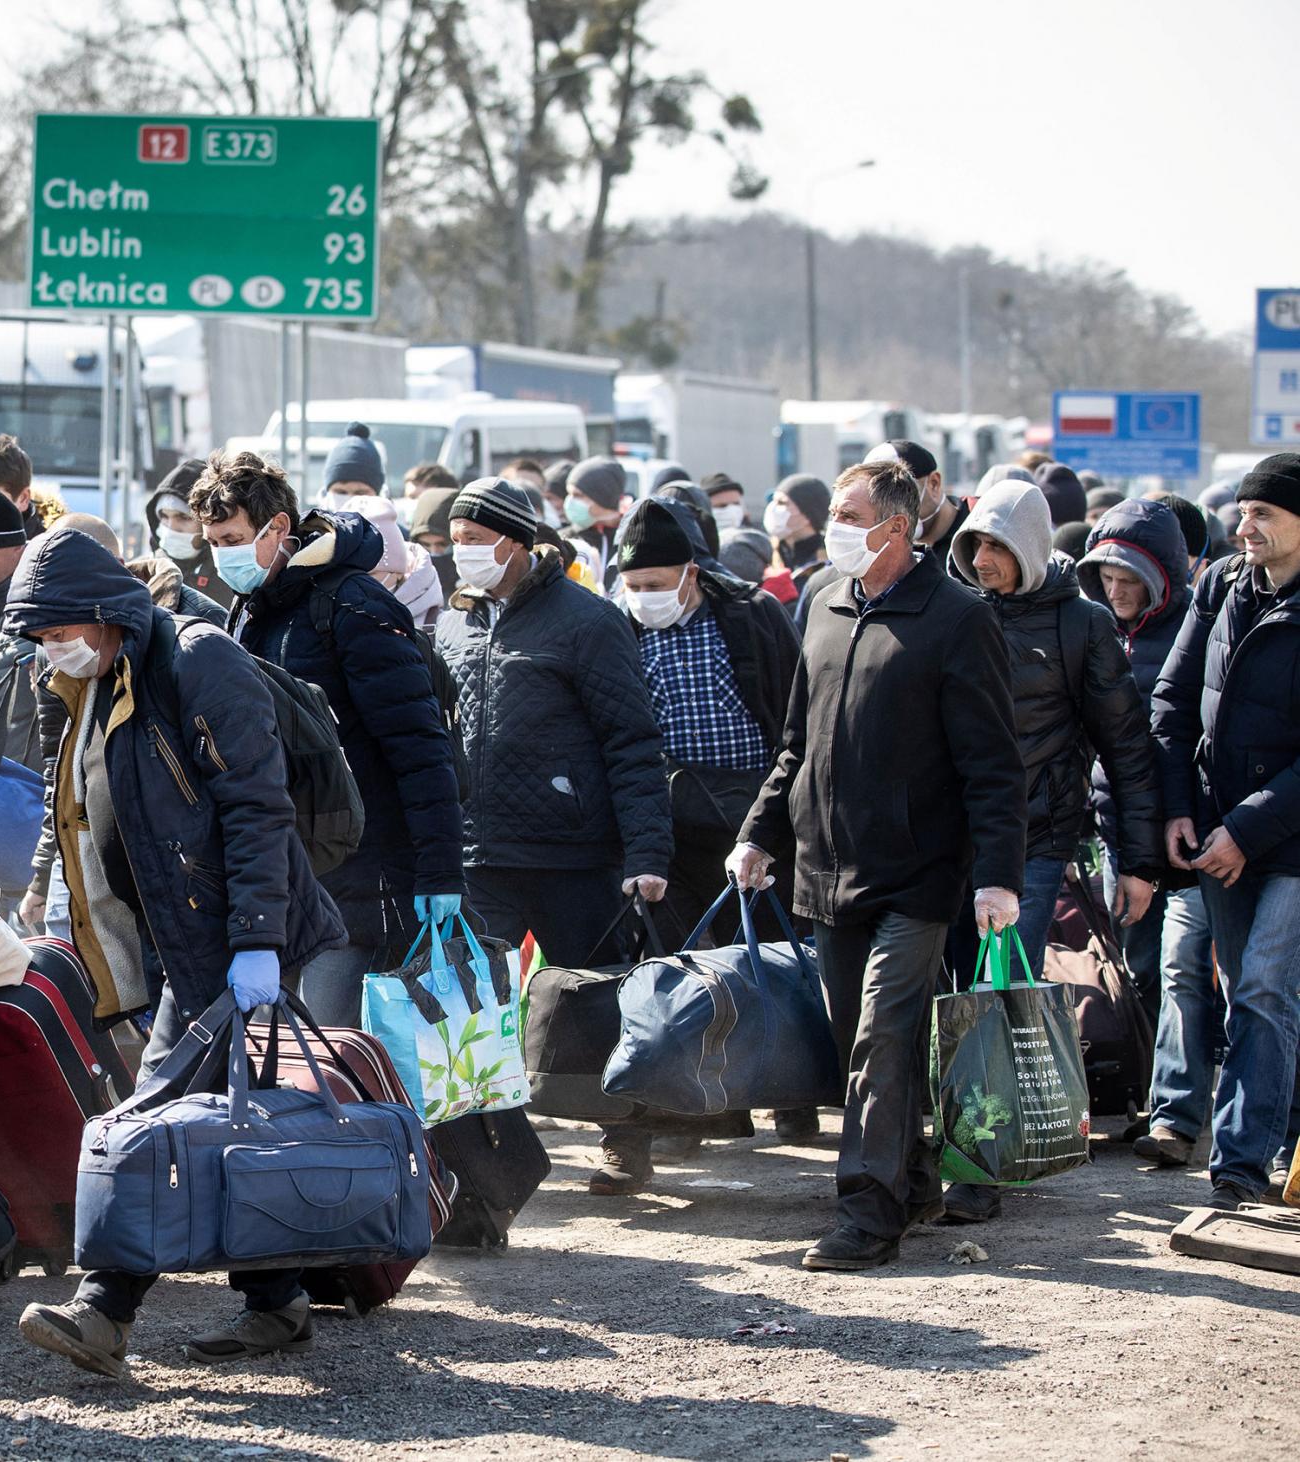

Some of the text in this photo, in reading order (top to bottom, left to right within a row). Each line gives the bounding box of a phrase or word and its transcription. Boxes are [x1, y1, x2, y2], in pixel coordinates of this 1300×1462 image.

[149, 133, 176, 159] 12
[43, 178, 367, 216] Chełm 26
[41, 227, 366, 265] Lublin 93
[199, 281, 225, 304] PL
[256, 282, 274, 303] D
[303, 278, 363, 310] 735
[1017, 1071, 1039, 1080] Soki
[1024, 1118, 1071, 1131] BEZ LAKTOZY
